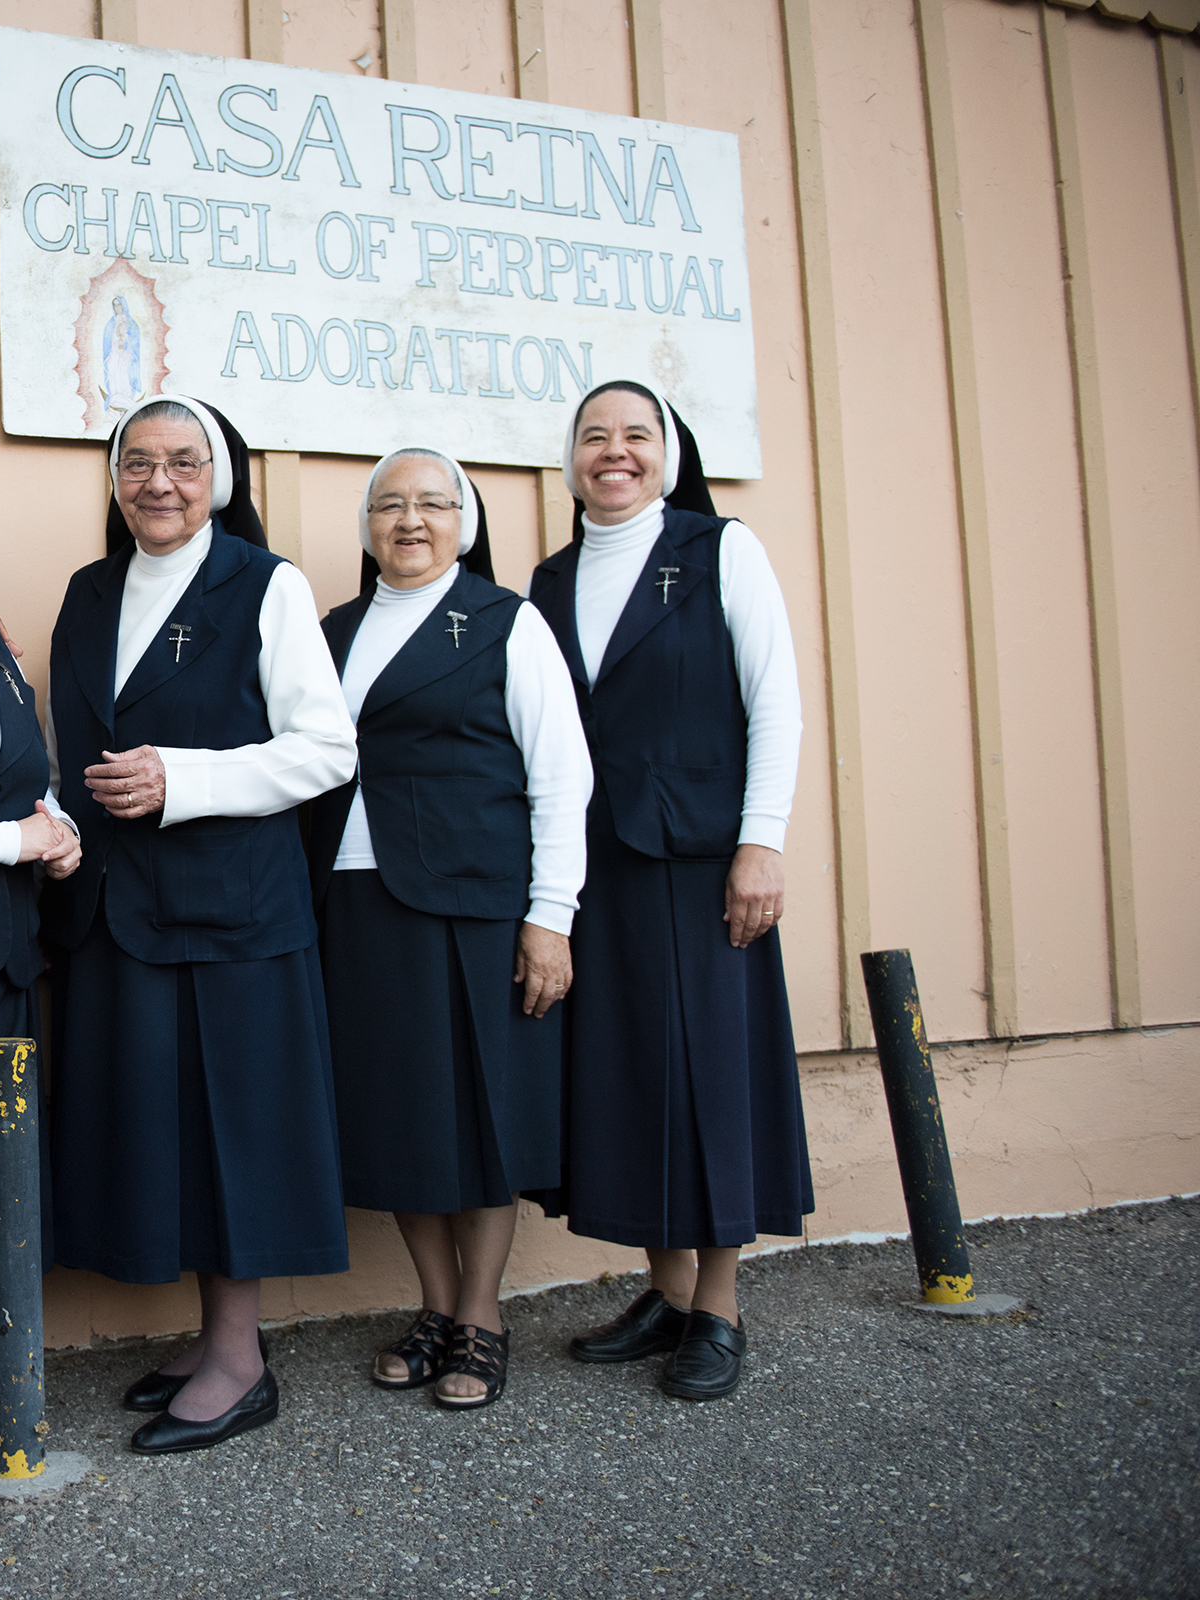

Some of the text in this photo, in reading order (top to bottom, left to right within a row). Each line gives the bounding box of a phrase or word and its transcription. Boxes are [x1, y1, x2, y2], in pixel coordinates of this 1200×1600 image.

[56, 65, 702, 233] CASA REINA
[23, 182, 741, 322] CHAPEL OF PERPETUAL
[220, 311, 593, 402] ADORATION
